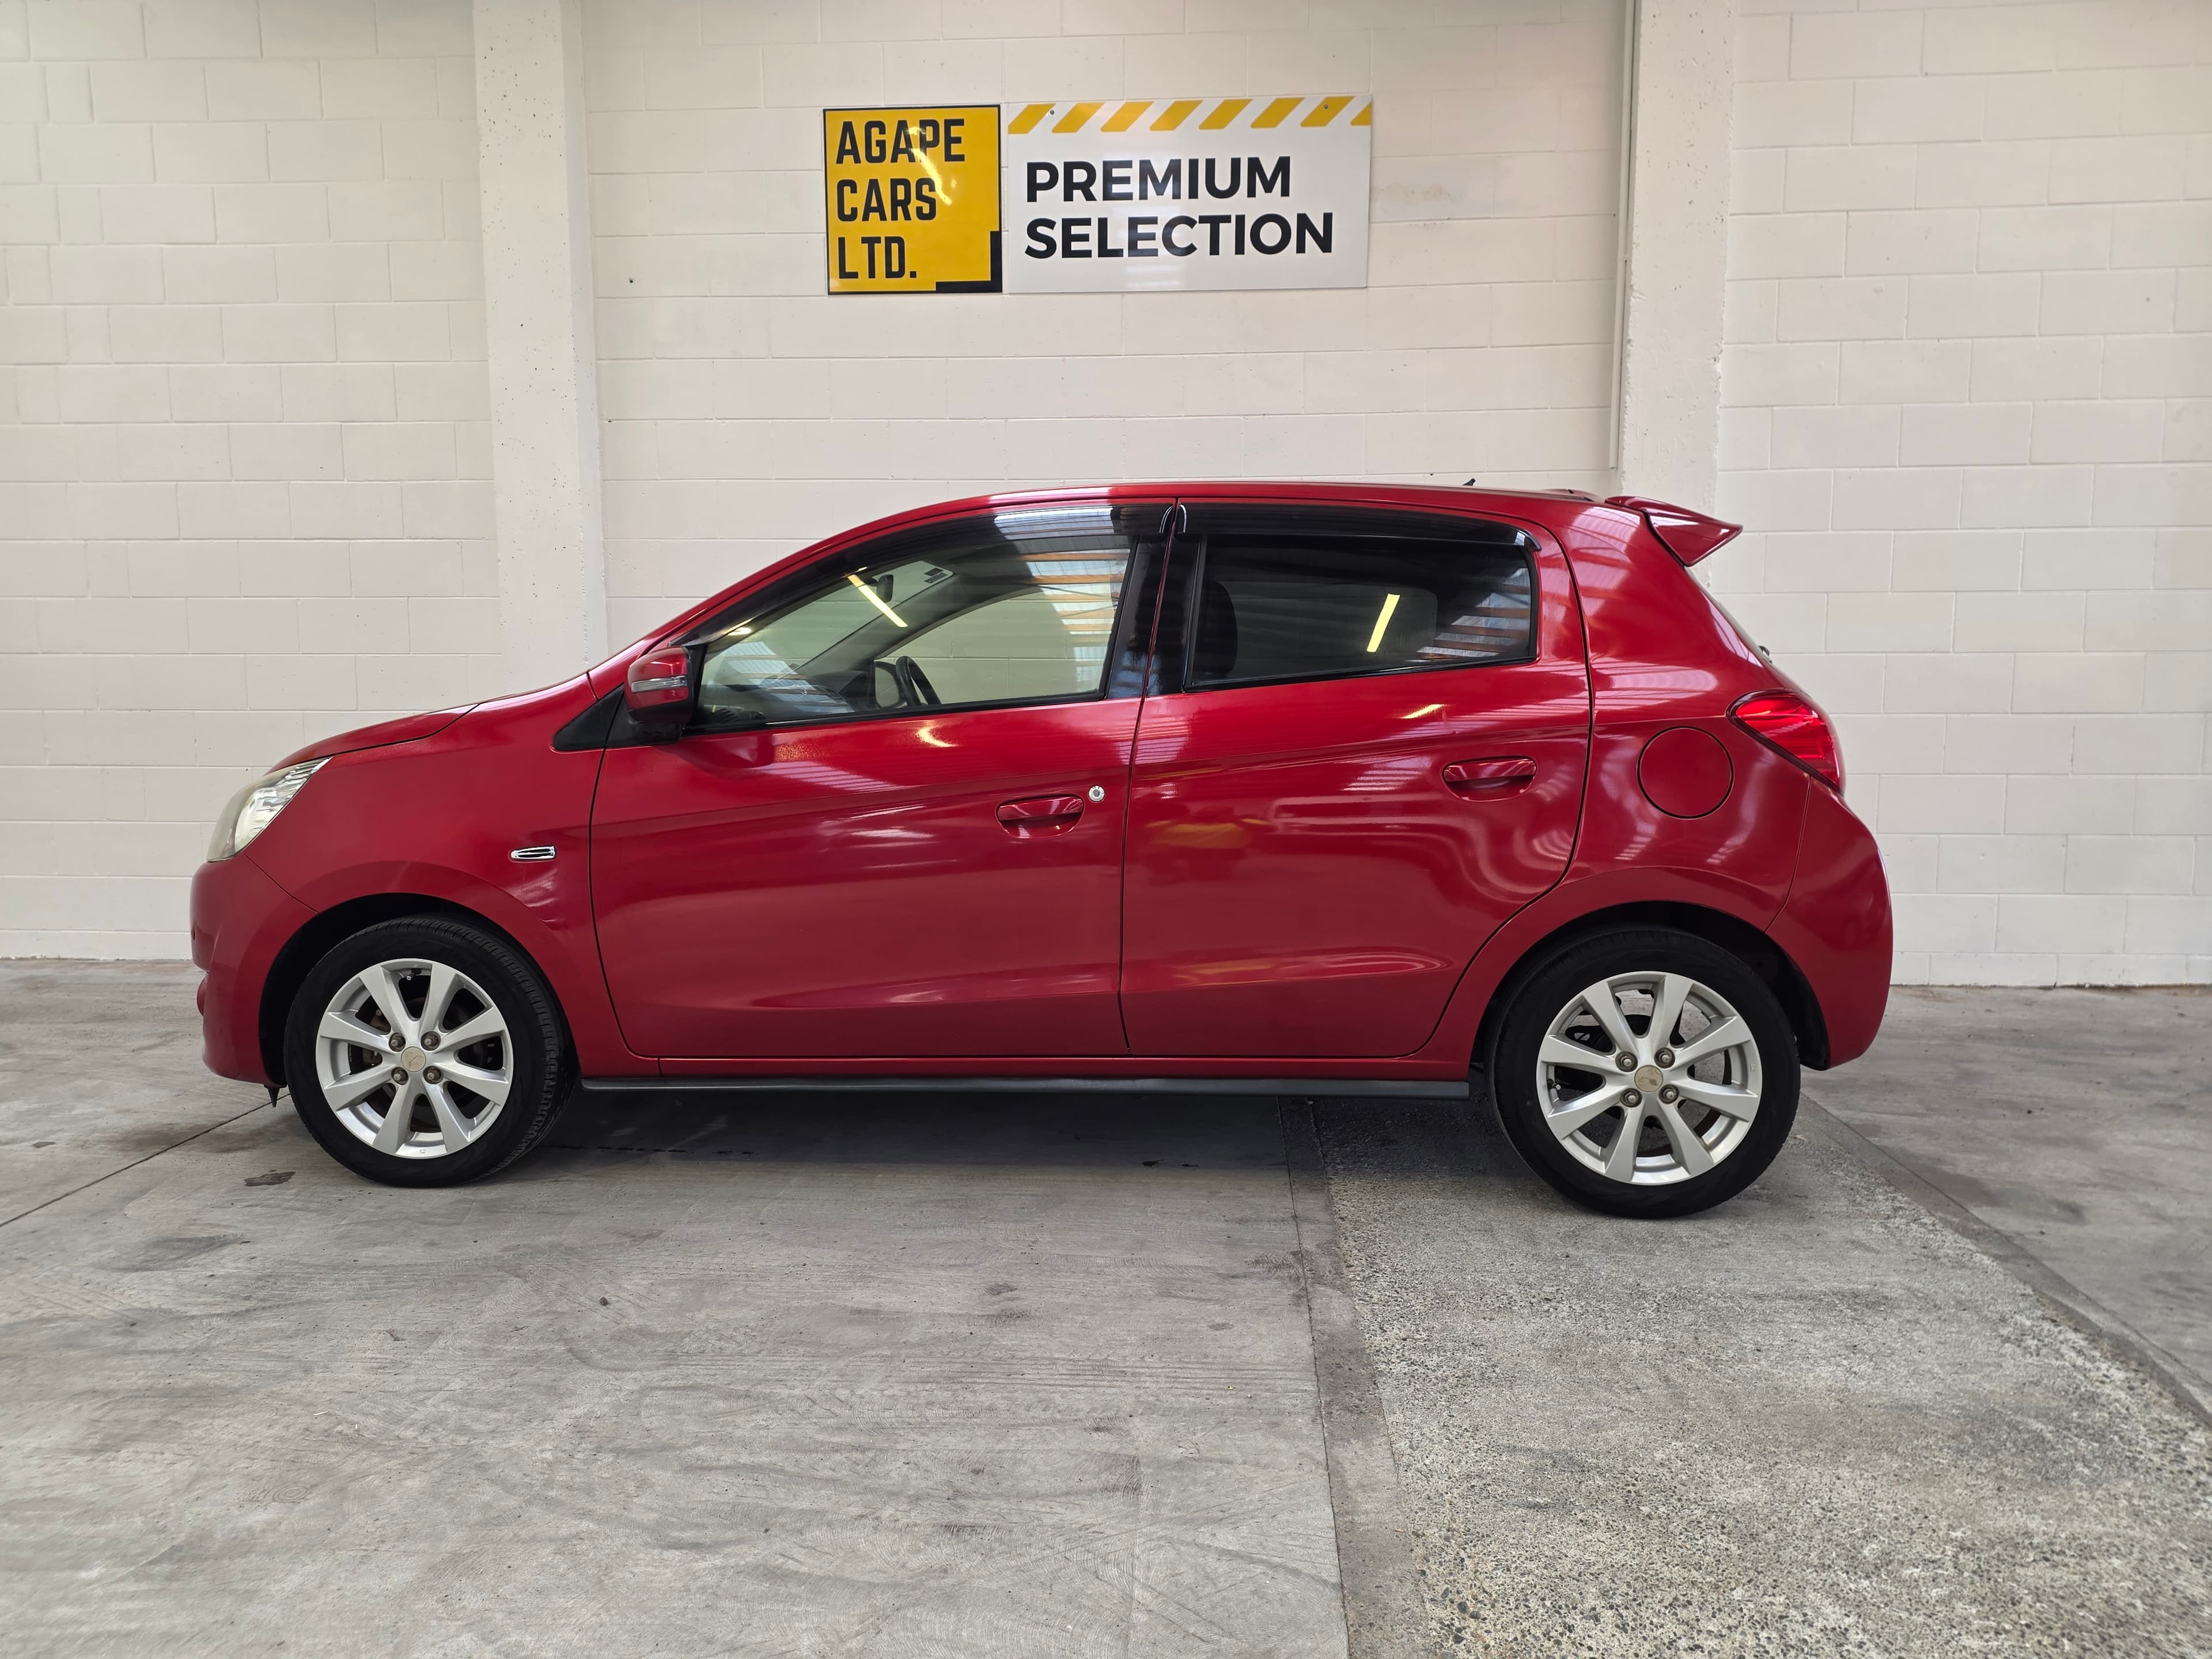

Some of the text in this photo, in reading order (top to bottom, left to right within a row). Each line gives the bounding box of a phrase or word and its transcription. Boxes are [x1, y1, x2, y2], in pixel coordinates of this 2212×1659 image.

[836, 119, 965, 164] AGAPE
[836, 177, 937, 222] CARS
[1027, 156, 1290, 203] PREMIUM
[838, 236, 917, 279] LTD.
[1024, 212, 1333, 259] SELECTION
